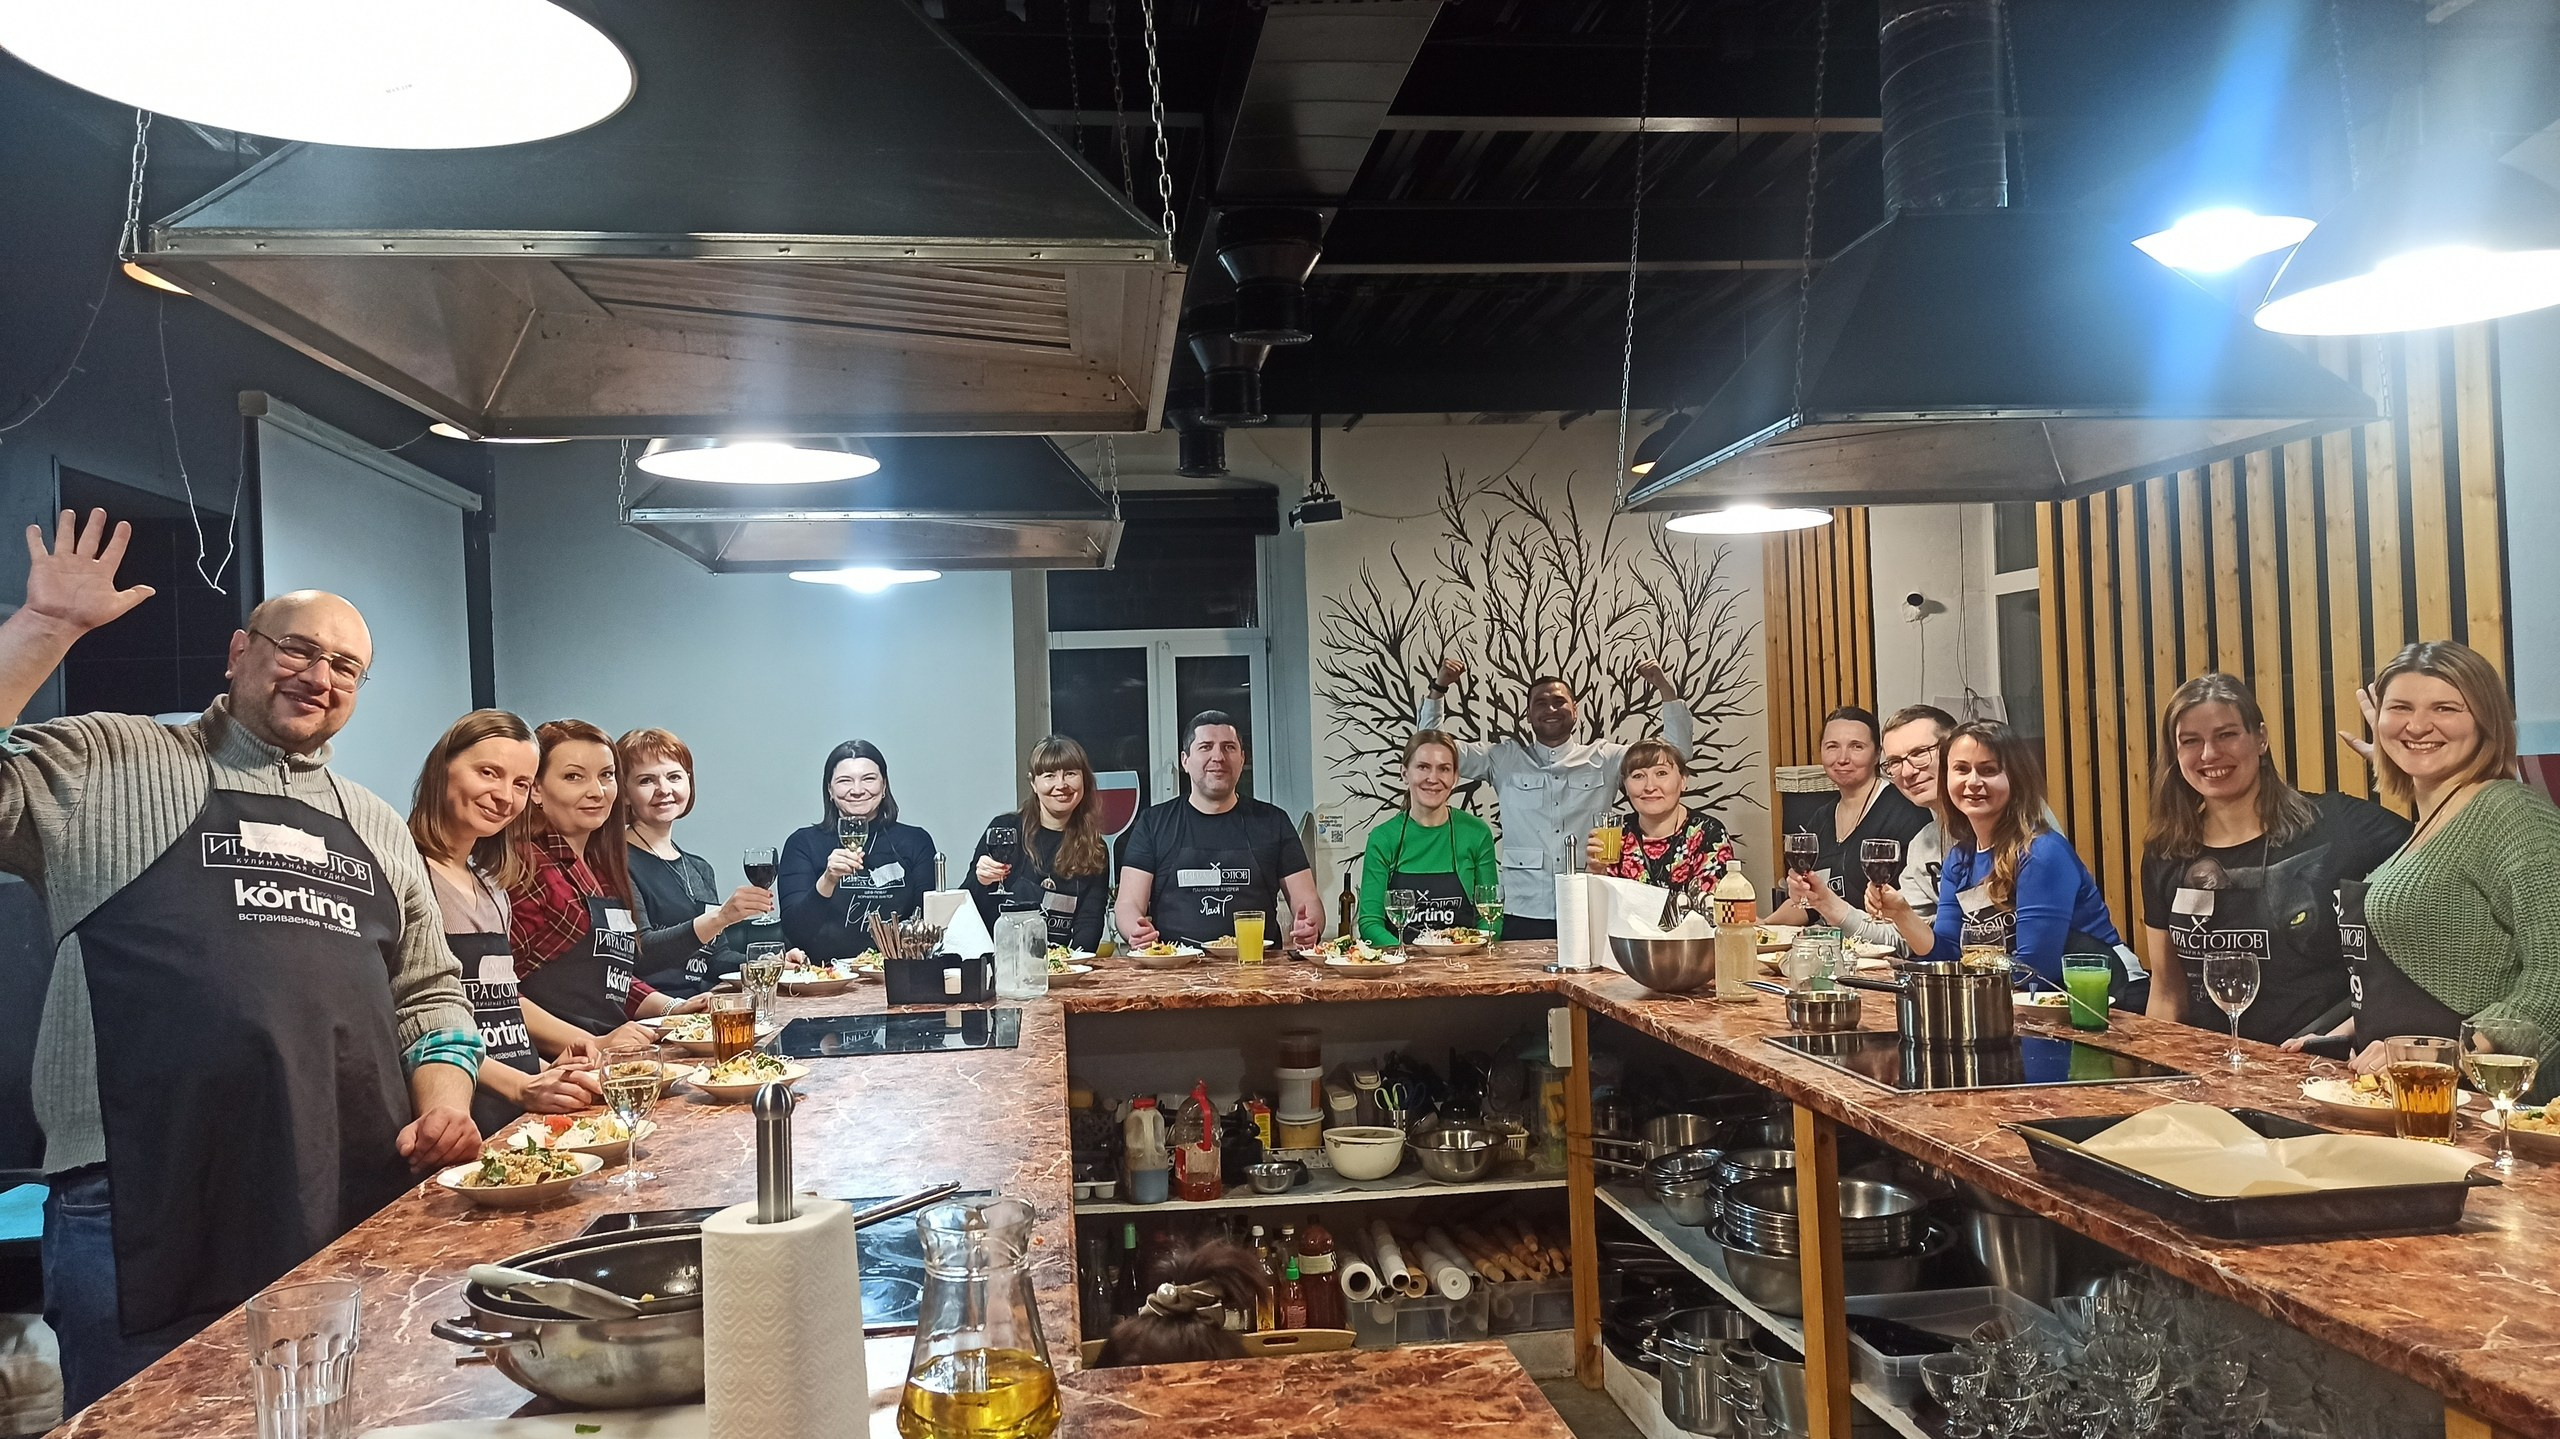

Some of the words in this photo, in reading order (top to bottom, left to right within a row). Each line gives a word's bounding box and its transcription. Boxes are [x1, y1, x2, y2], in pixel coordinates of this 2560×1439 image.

[209, 837, 276, 859] ИГА
[282, 853, 367, 881] ЛОВ
[236, 857, 308, 872] КУЛИНАРНАЯ
[311, 868, 346, 882] СТУДИЯ
[234, 879, 357, 930] körting
[1406, 907, 1455, 925] rting
[238, 913, 321, 927] встраиваемая
[322, 922, 362, 938] техника
[2188, 933, 2264, 950] СТОЛОВ
[462, 982, 490, 1000] ГРА
